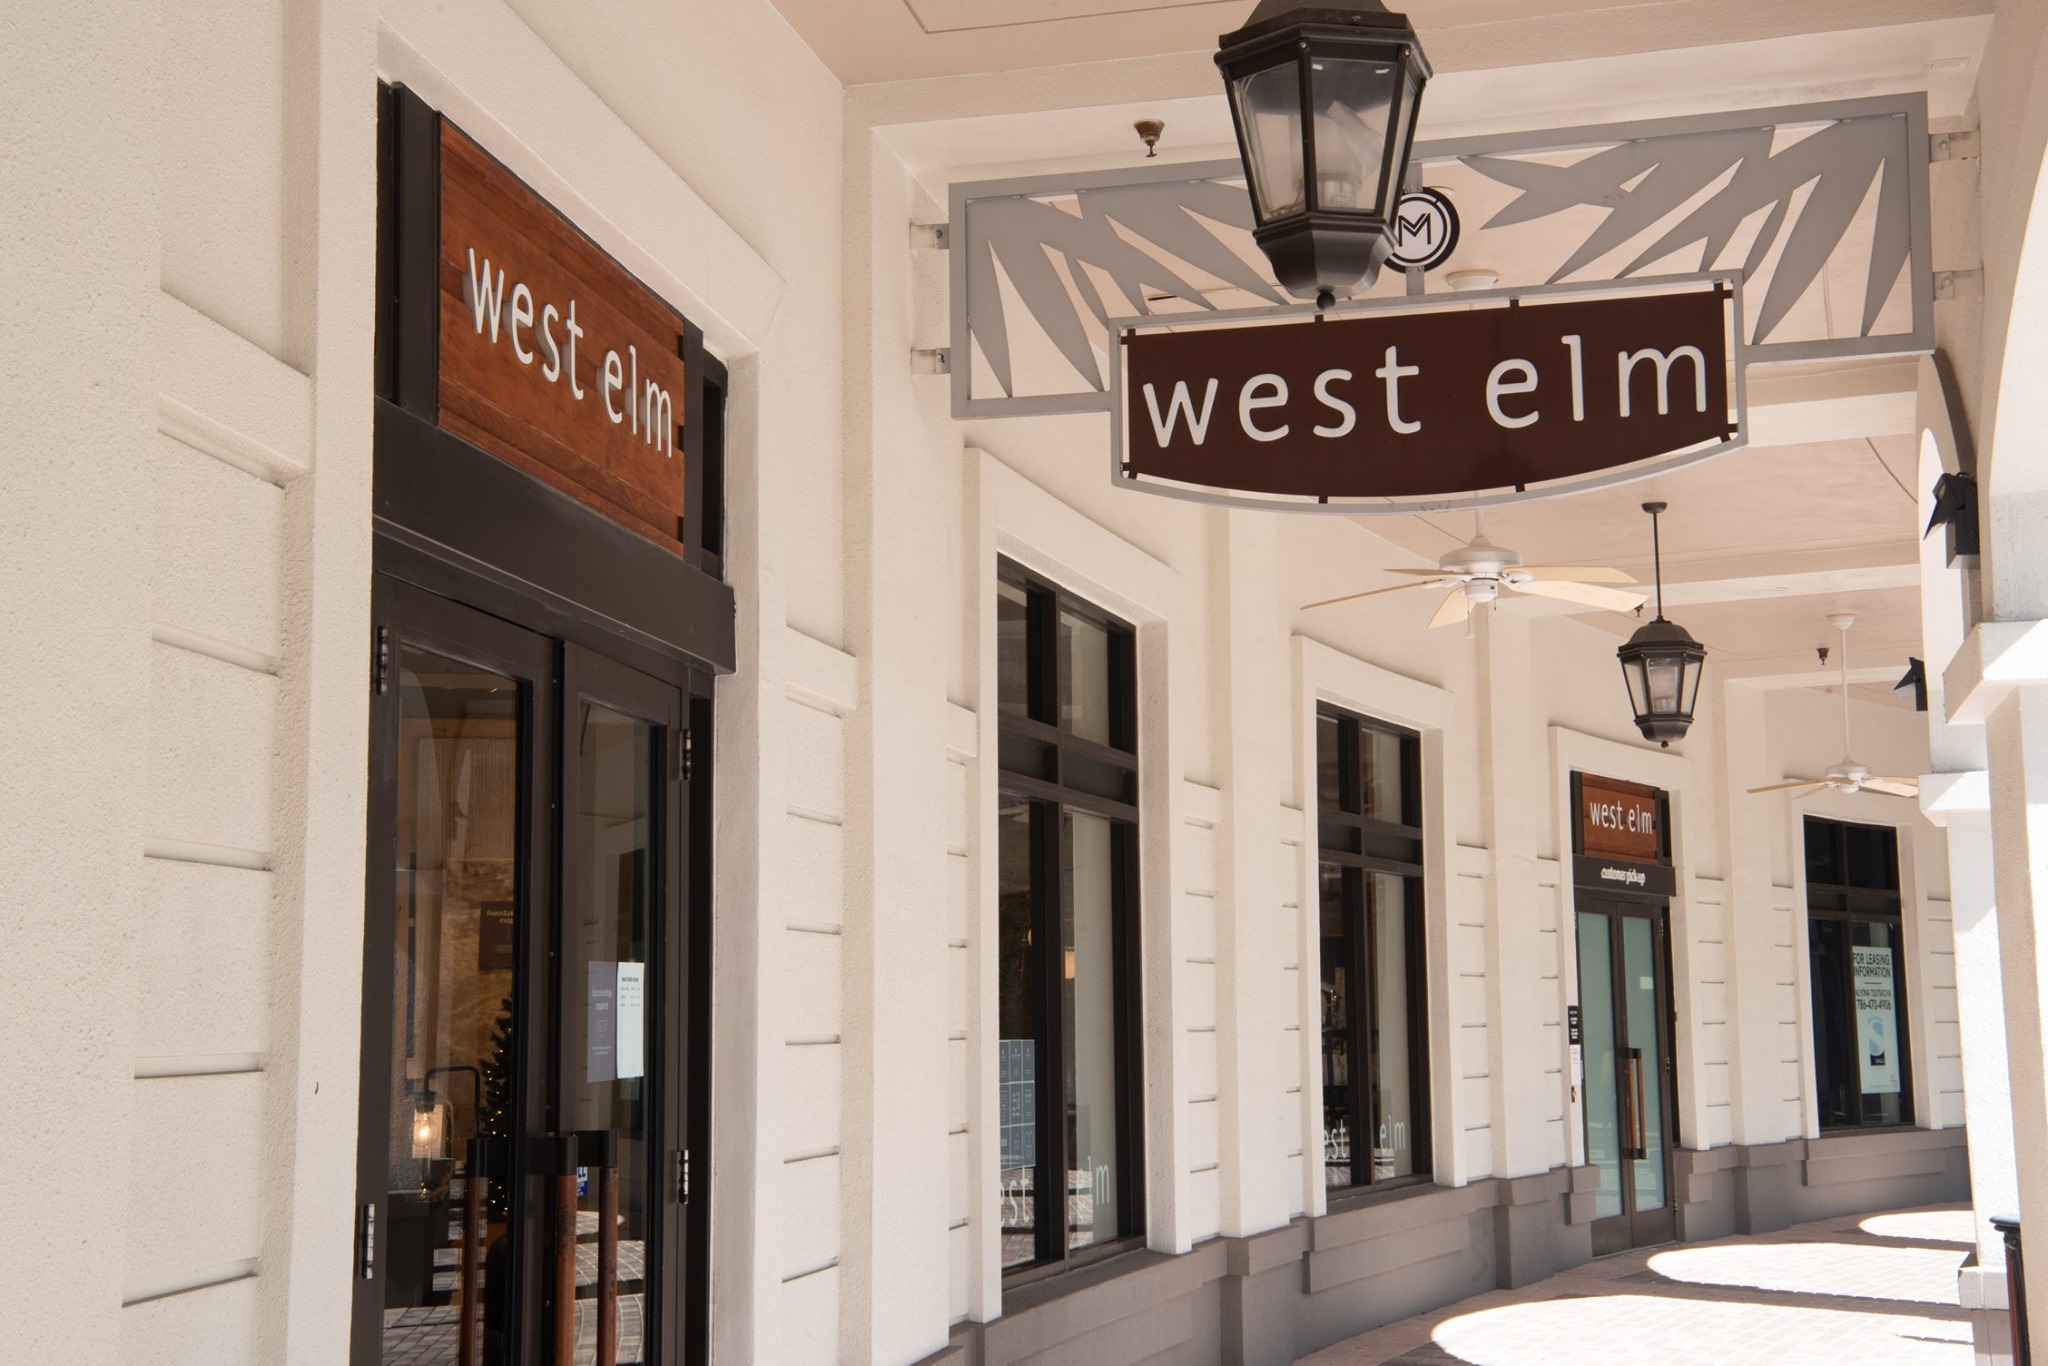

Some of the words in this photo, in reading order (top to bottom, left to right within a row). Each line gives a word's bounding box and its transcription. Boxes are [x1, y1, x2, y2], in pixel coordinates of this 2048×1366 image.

[466, 247, 584, 401] west
[602, 344, 673, 459] elm
[1142, 345, 1422, 449] west
[1485, 334, 1708, 430] elm
[1589, 800, 1624, 831] west
[1628, 804, 1653, 834] elm
[1600, 866, 1626, 881] customer
[1853, 952, 1865, 965] FOR
[1866, 953, 1891, 966] LEASING
[1857, 999, 1892, 1010] 786-470-4906
[1380, 1113, 1405, 1152] elm
